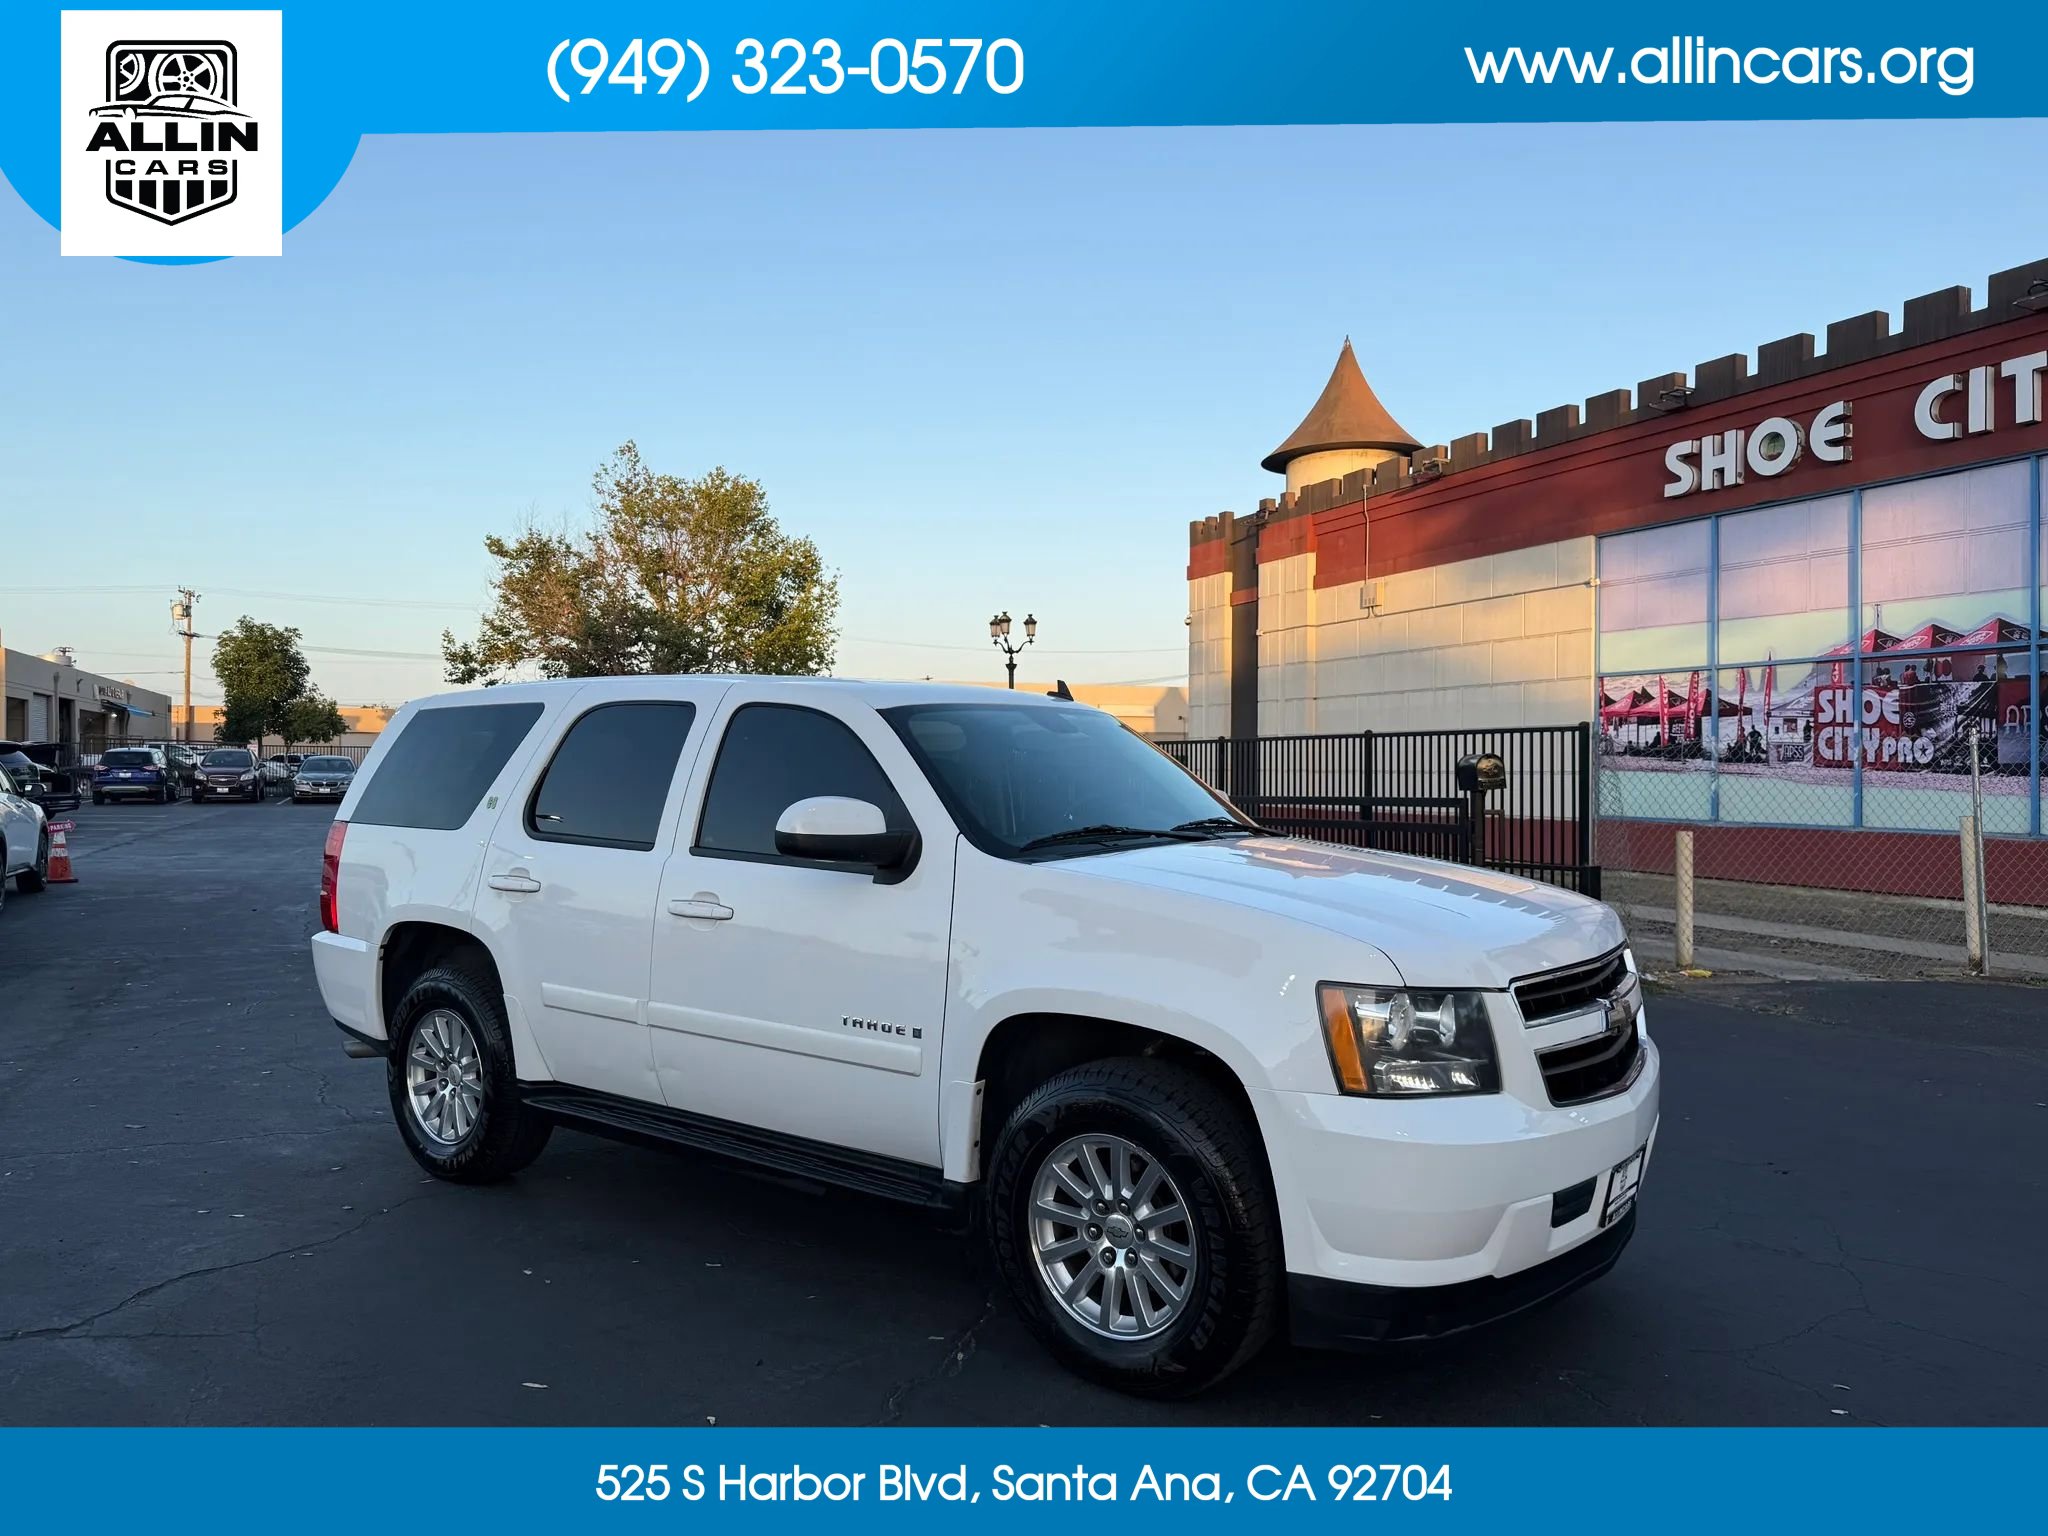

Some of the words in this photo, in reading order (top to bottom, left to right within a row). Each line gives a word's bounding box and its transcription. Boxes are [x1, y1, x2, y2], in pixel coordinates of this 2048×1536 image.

[1664, 400, 1853, 498] SHOE
[1914, 350, 2048, 441] CIT
[1818, 688, 1900, 725] SHOE
[1817, 726, 1881, 764] CITY
[1882, 736, 1934, 764] PRO
[840, 1014, 907, 1036] TAHOE
